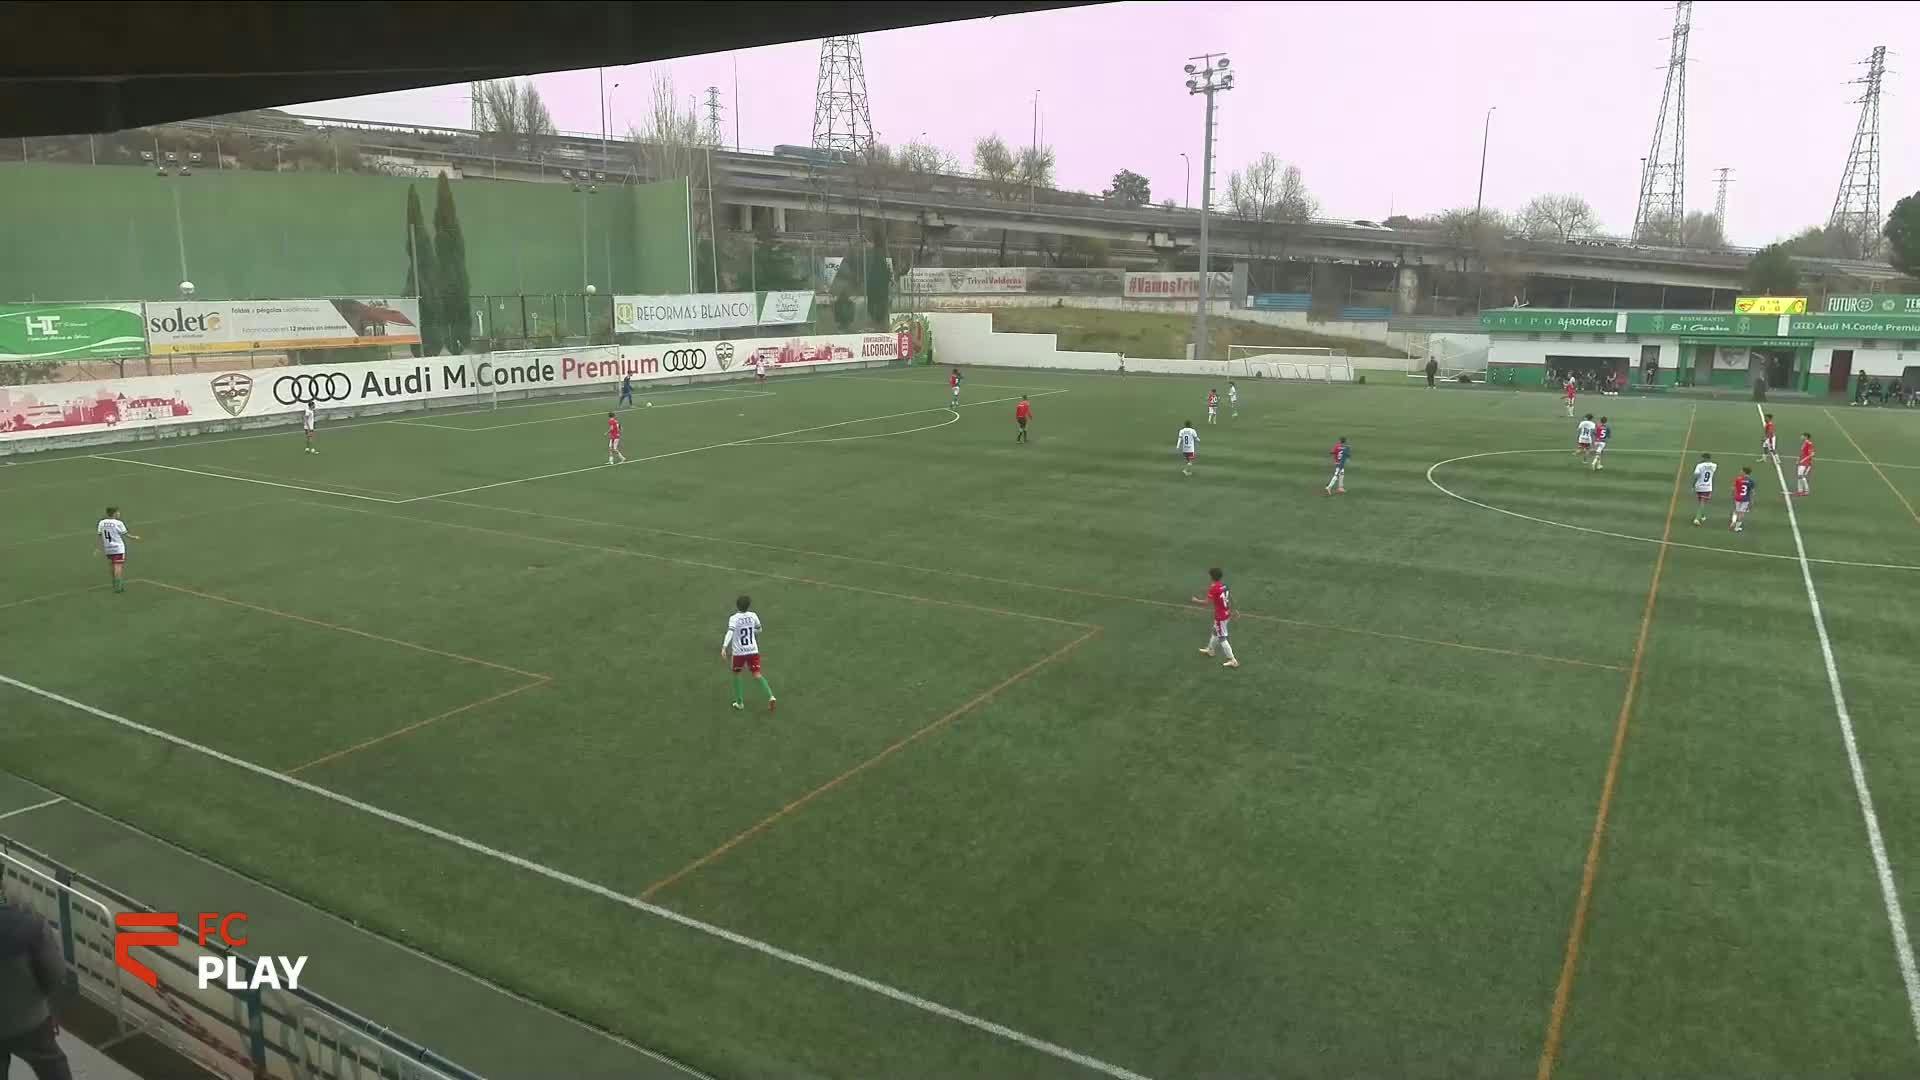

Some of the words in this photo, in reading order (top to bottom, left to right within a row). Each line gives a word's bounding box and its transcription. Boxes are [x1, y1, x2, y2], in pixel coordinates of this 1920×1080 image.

[637, 303, 697, 321] REFORMAS
[1816, 322, 1839, 331] Audi
[1841, 322, 1883, 332] M.Conde
[361, 366, 432, 398] Audi
[443, 358, 555, 390] M.Conde
[562, 354, 659, 380] Premium
[1184, 435, 1189, 445] 8
[1703, 471, 1711, 483] 9
[1740, 485, 1748, 496] 3
[104, 529, 112, 543] 4
[740, 627, 753, 646] 21
